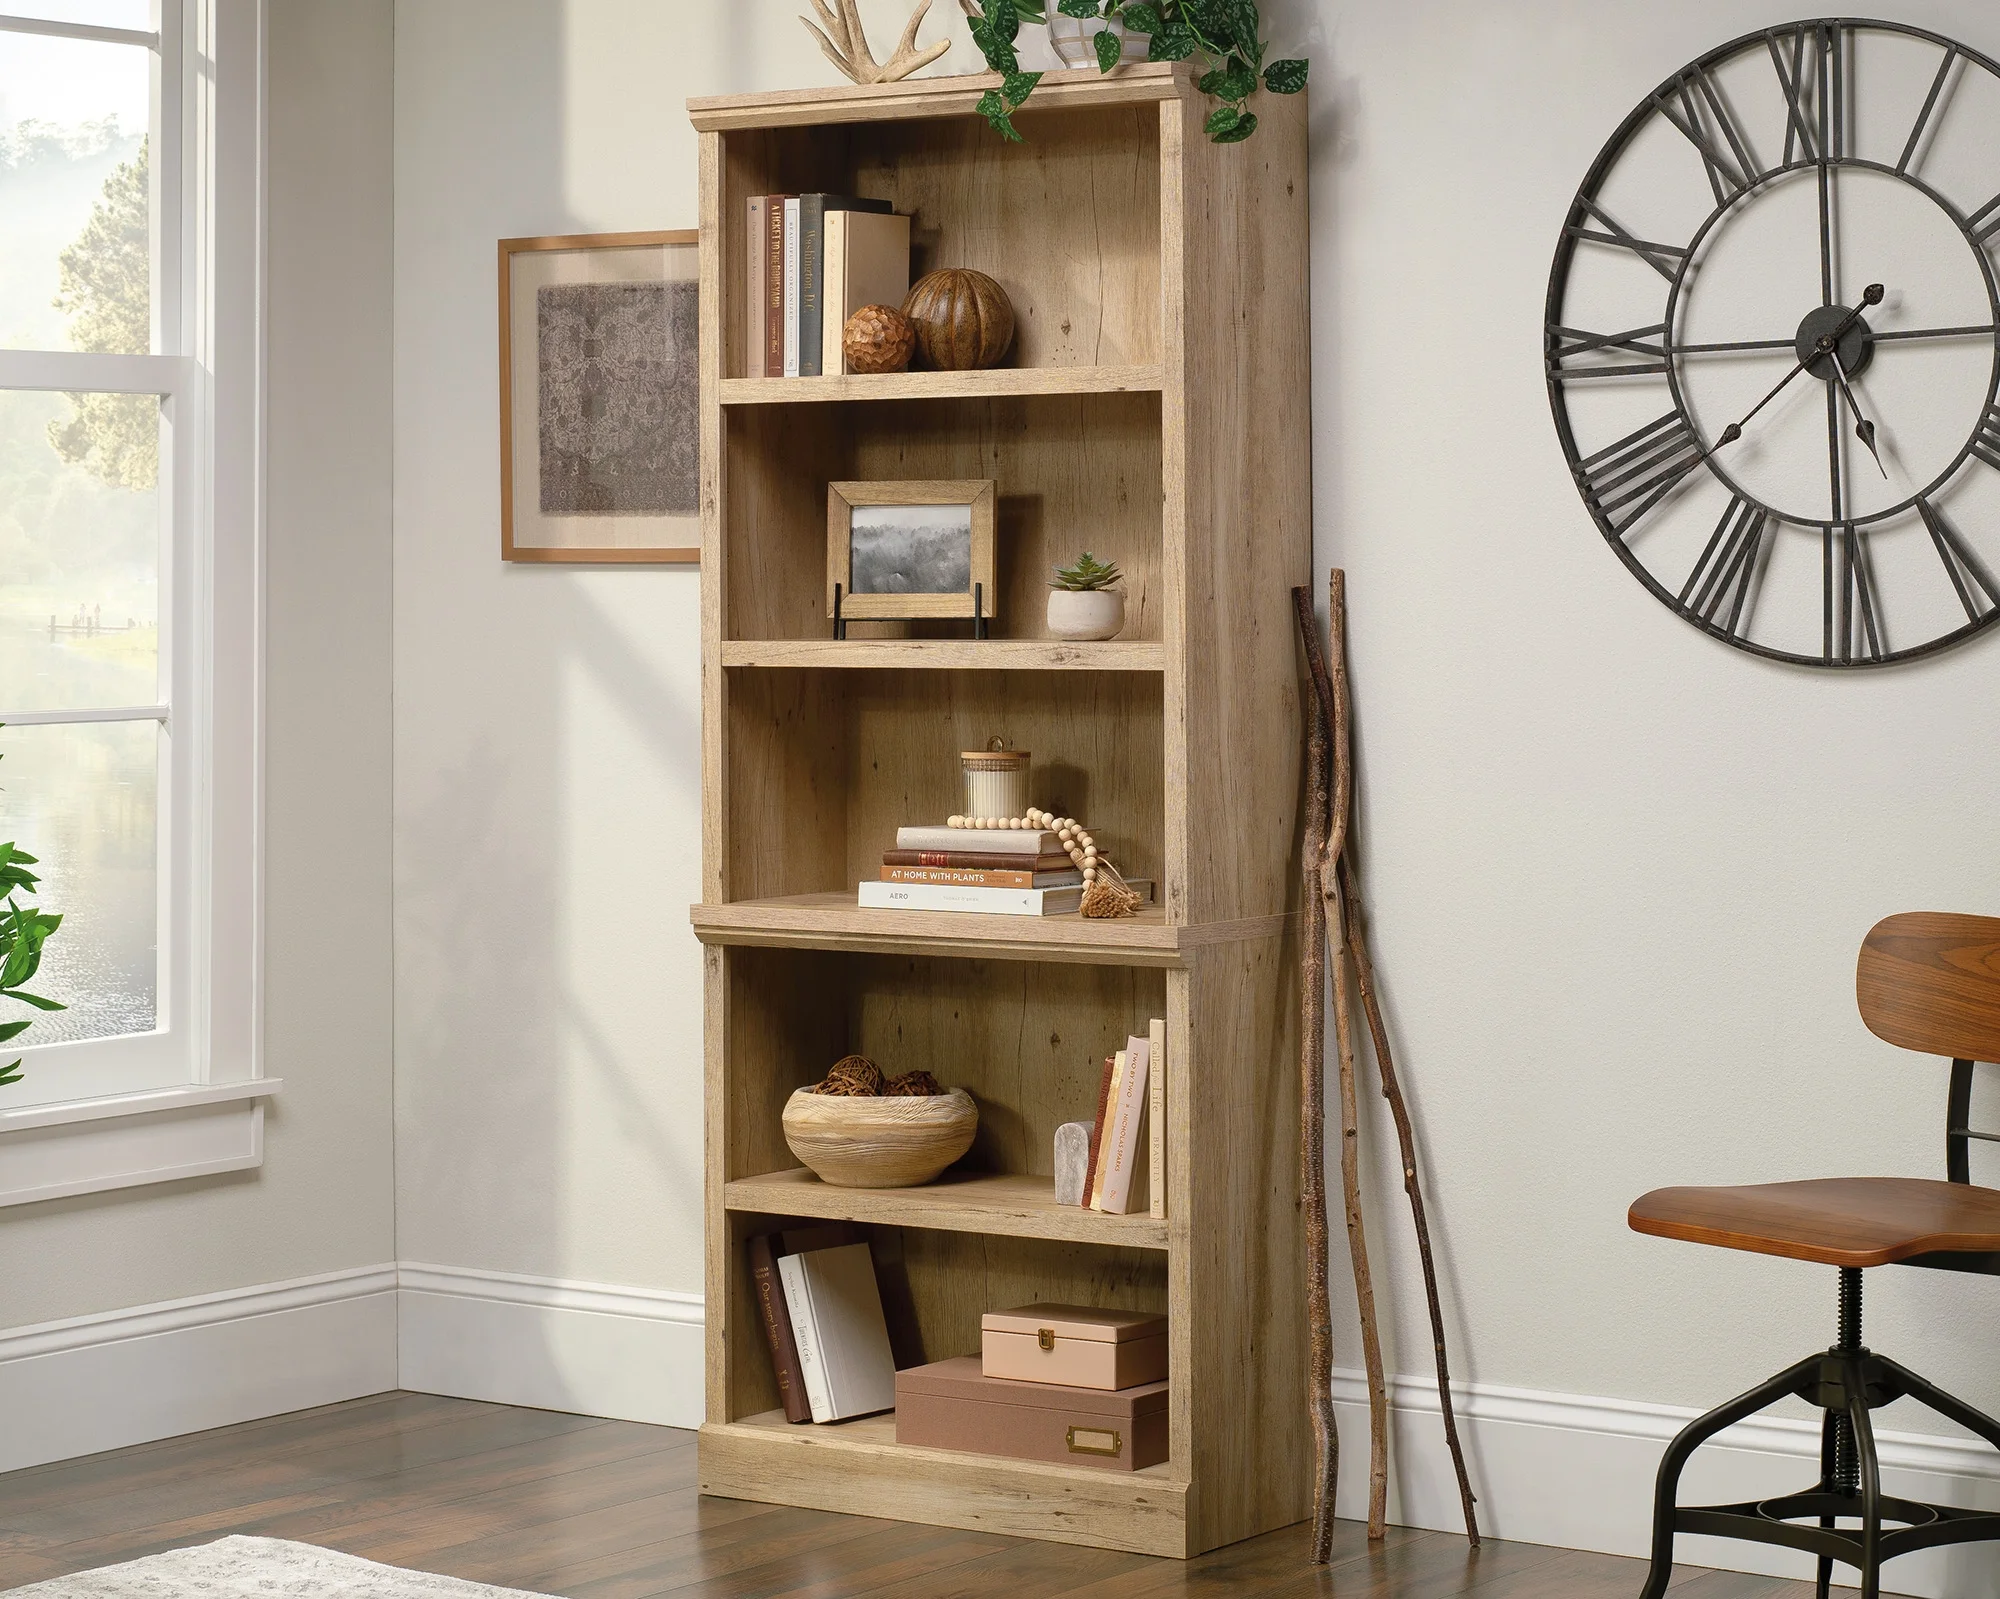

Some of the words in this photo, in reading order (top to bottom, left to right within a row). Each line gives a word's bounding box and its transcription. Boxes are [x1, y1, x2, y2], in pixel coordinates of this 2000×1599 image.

[1766, 20, 1843, 166] XII
[1650, 63, 1759, 208] XI
[771, 211, 782, 239] TICKET
[771, 240, 782, 250] TO
[1565, 194, 1691, 283] X
[771, 250, 782, 265] THE
[803, 230, 816, 292] Washington,
[803, 294, 816, 313] D.C.
[1546, 323, 1670, 381] IX
[1574, 409, 1708, 543] VIII
[1676, 497, 1768, 644] VII
[1822, 522, 1880, 666] VI
[891, 870, 903, 879] AT
[904, 871, 928, 880] HOME
[929, 872, 951, 882] WITH
[952, 873, 985, 883] PLANTS
[889, 891, 909, 901] AERO
[1129, 1052, 1139, 1070] TWO
[1152, 1041, 1160, 1072] Called
[1128, 1070, 1136, 1080] BY
[1126, 1080, 1135, 1098] TWO
[1152, 1086, 1163, 1112] Life
[1117, 1113, 1129, 1148] NICHOLAS
[1114, 1148, 1124, 1172] SPARKS
[761, 1282, 771, 1301] Our
[765, 1302, 775, 1323] story
[769, 1323, 781, 1350] begins
